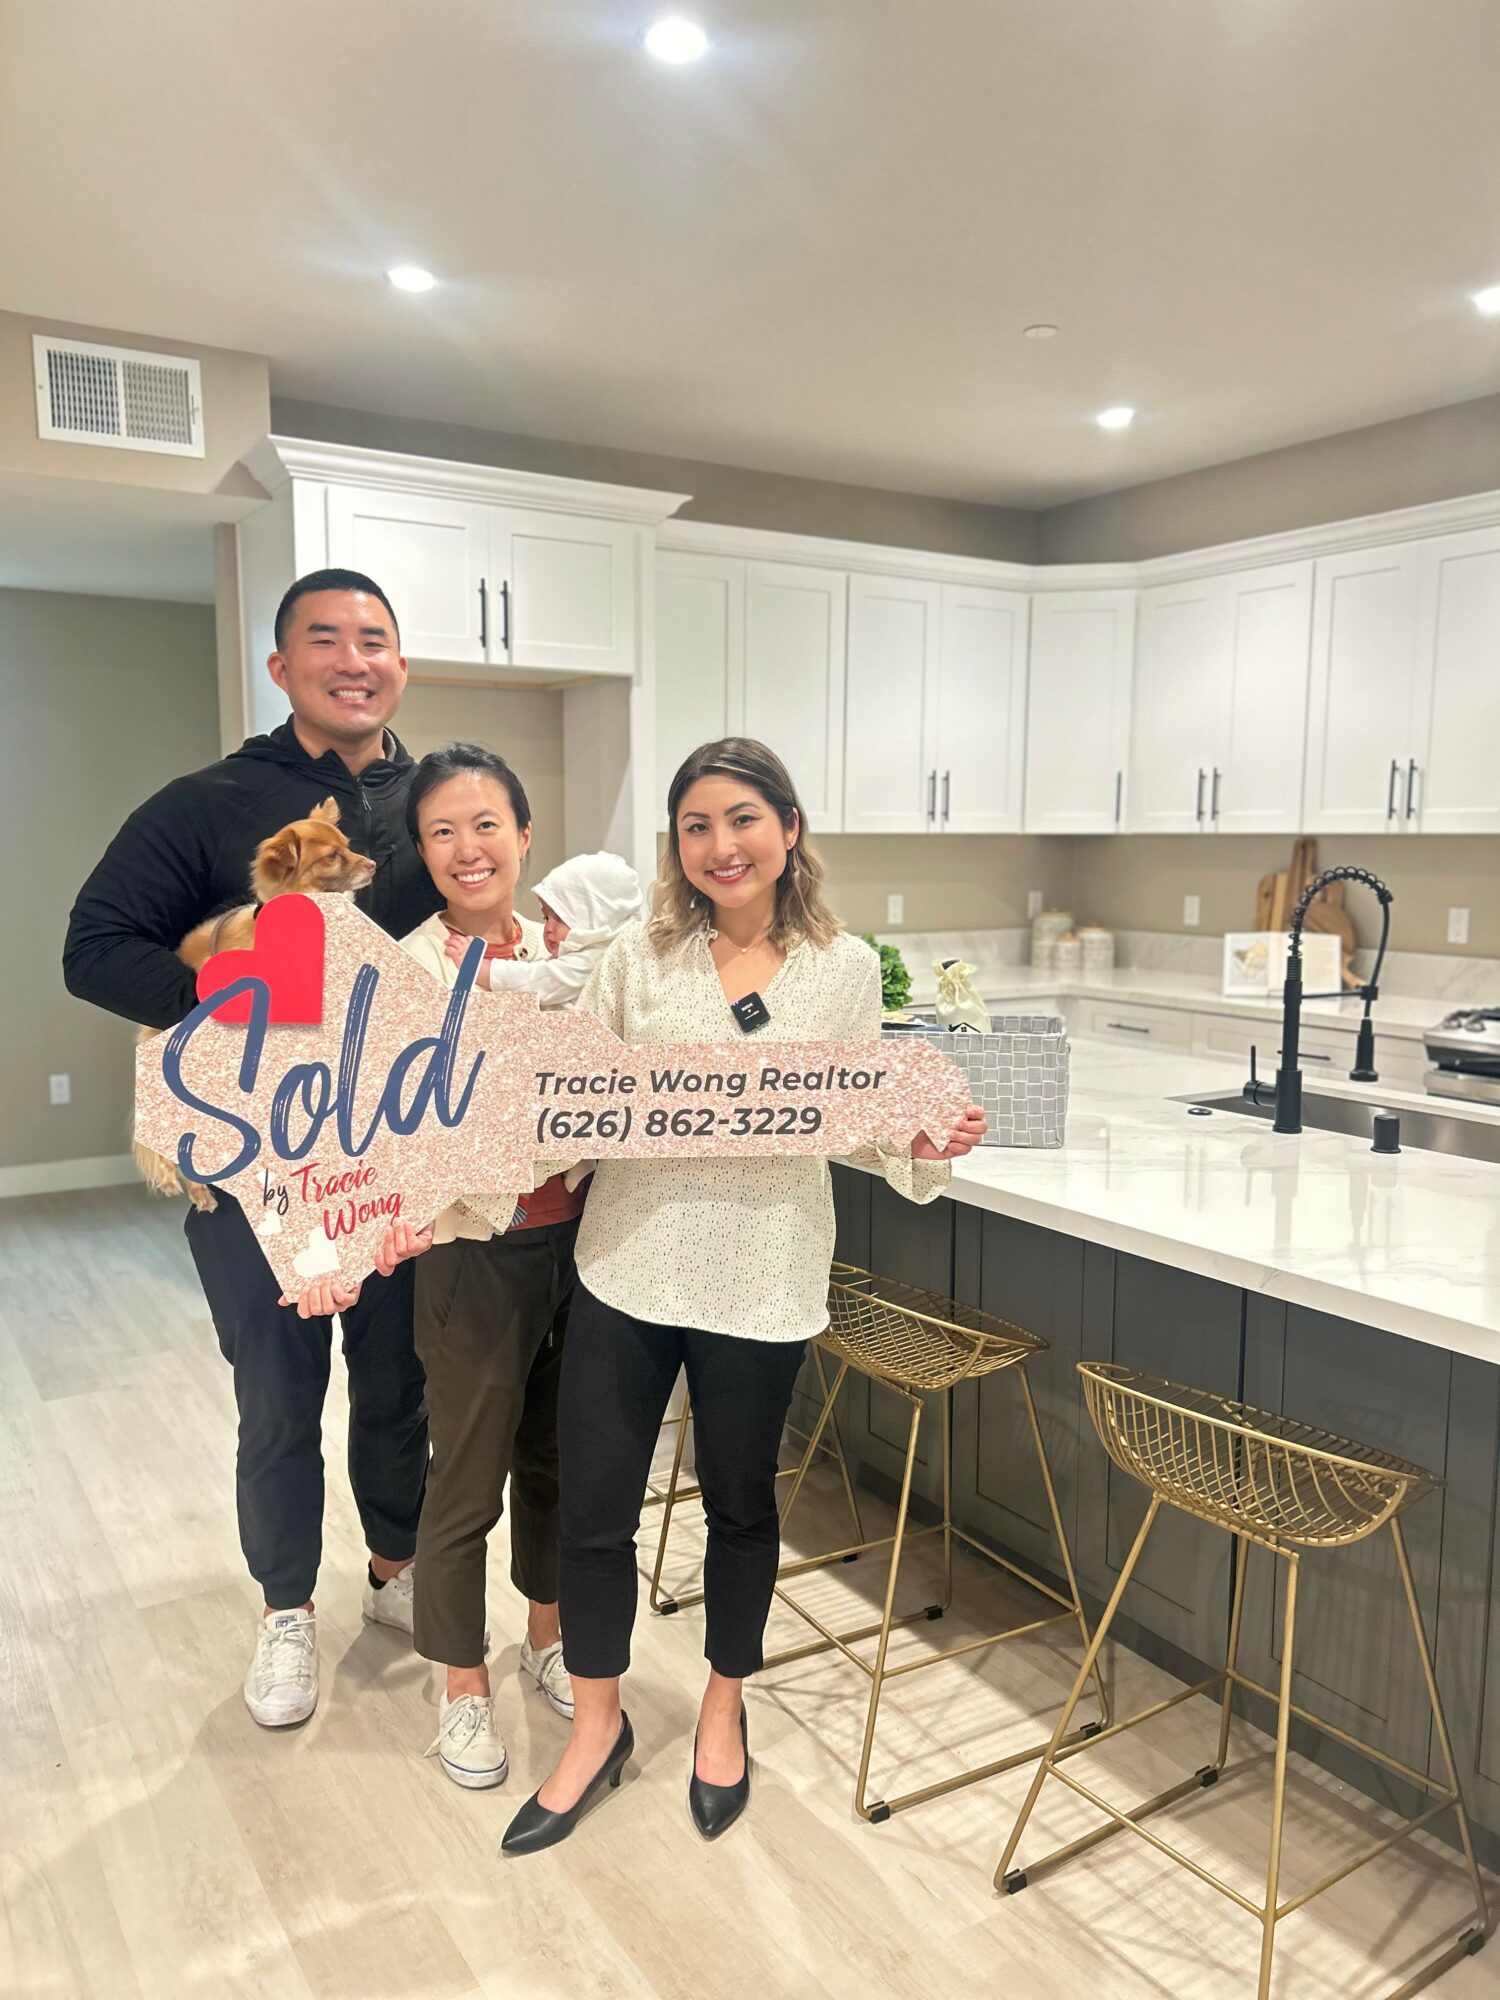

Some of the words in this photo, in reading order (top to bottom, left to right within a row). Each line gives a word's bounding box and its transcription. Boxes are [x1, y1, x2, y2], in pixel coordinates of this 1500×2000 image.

[162, 936, 486, 1184] Sold
[535, 1068, 637, 1096] Tracie
[650, 1067, 747, 1097] Wong
[759, 1065, 887, 1091] Realtor
[536, 1107, 632, 1143] (626)
[645, 1106, 822, 1138] 862-3229
[263, 1168, 289, 1216] by
[290, 1159, 378, 1203] Tracie
[323, 1193, 404, 1240] Wong
